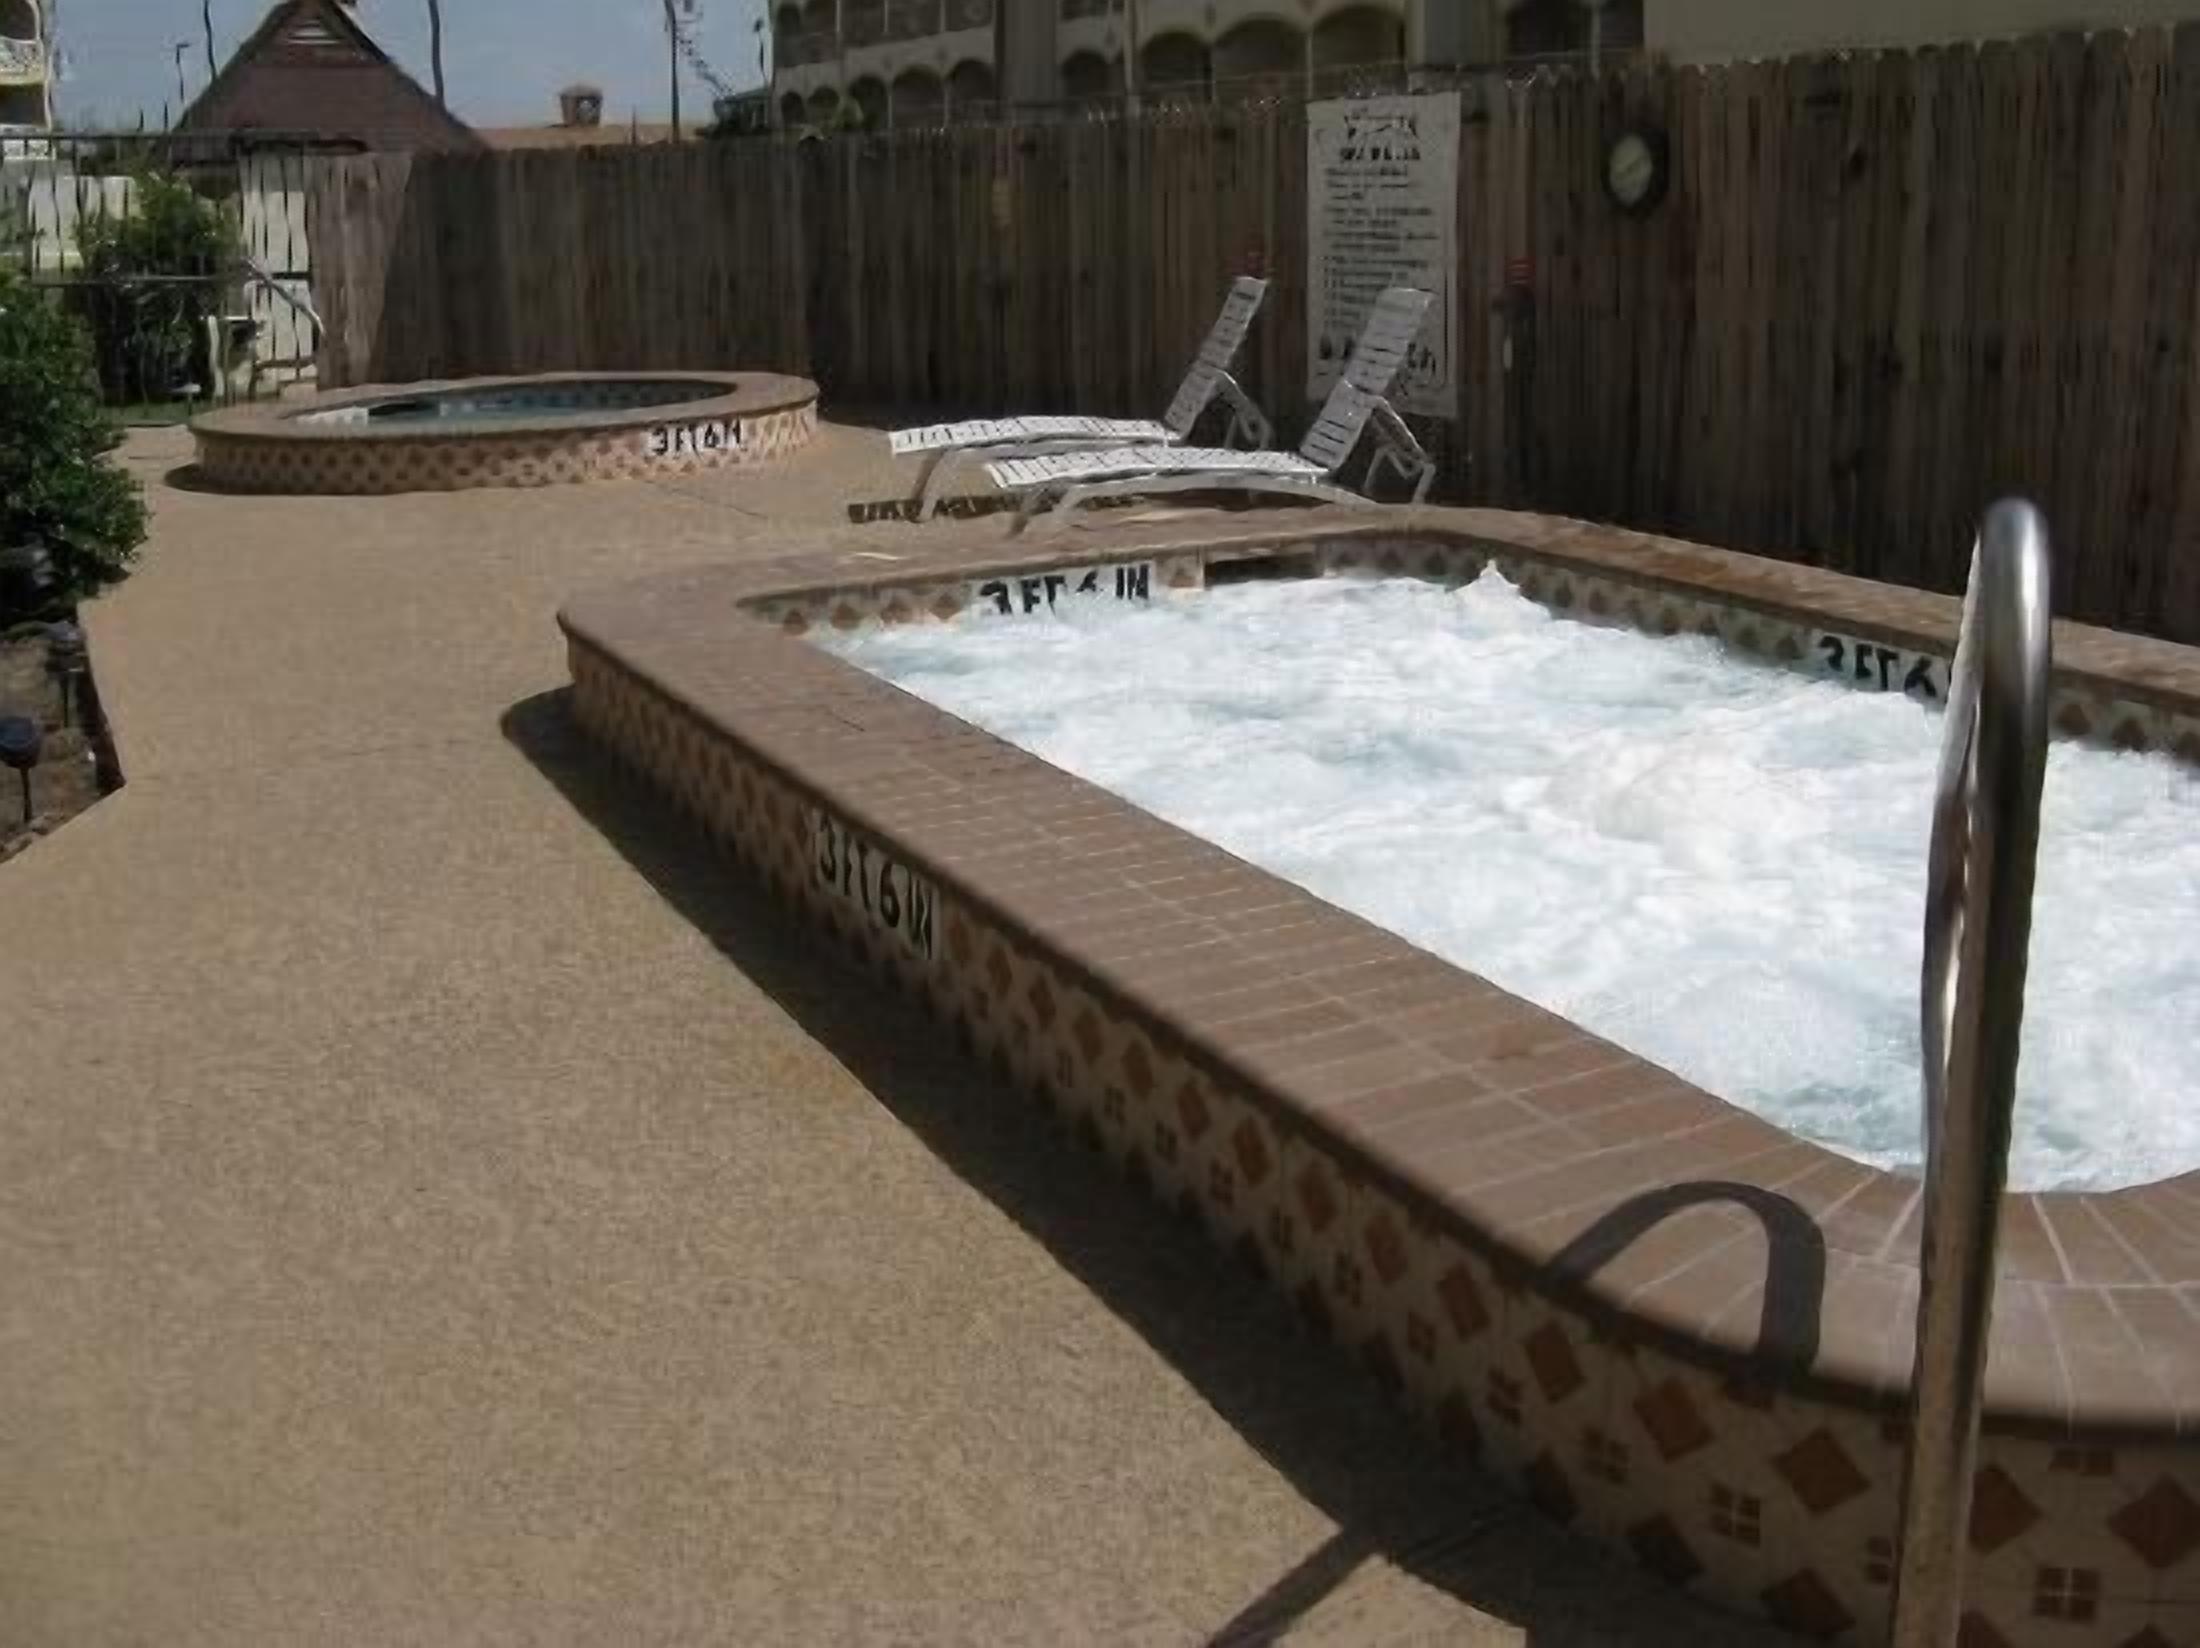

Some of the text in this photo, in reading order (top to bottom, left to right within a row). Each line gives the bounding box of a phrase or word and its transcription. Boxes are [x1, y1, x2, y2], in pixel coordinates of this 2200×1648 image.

[1020, 575, 1067, 614] FT
[1115, 563, 1149, 600] IN
[1855, 643, 1899, 691] FT
